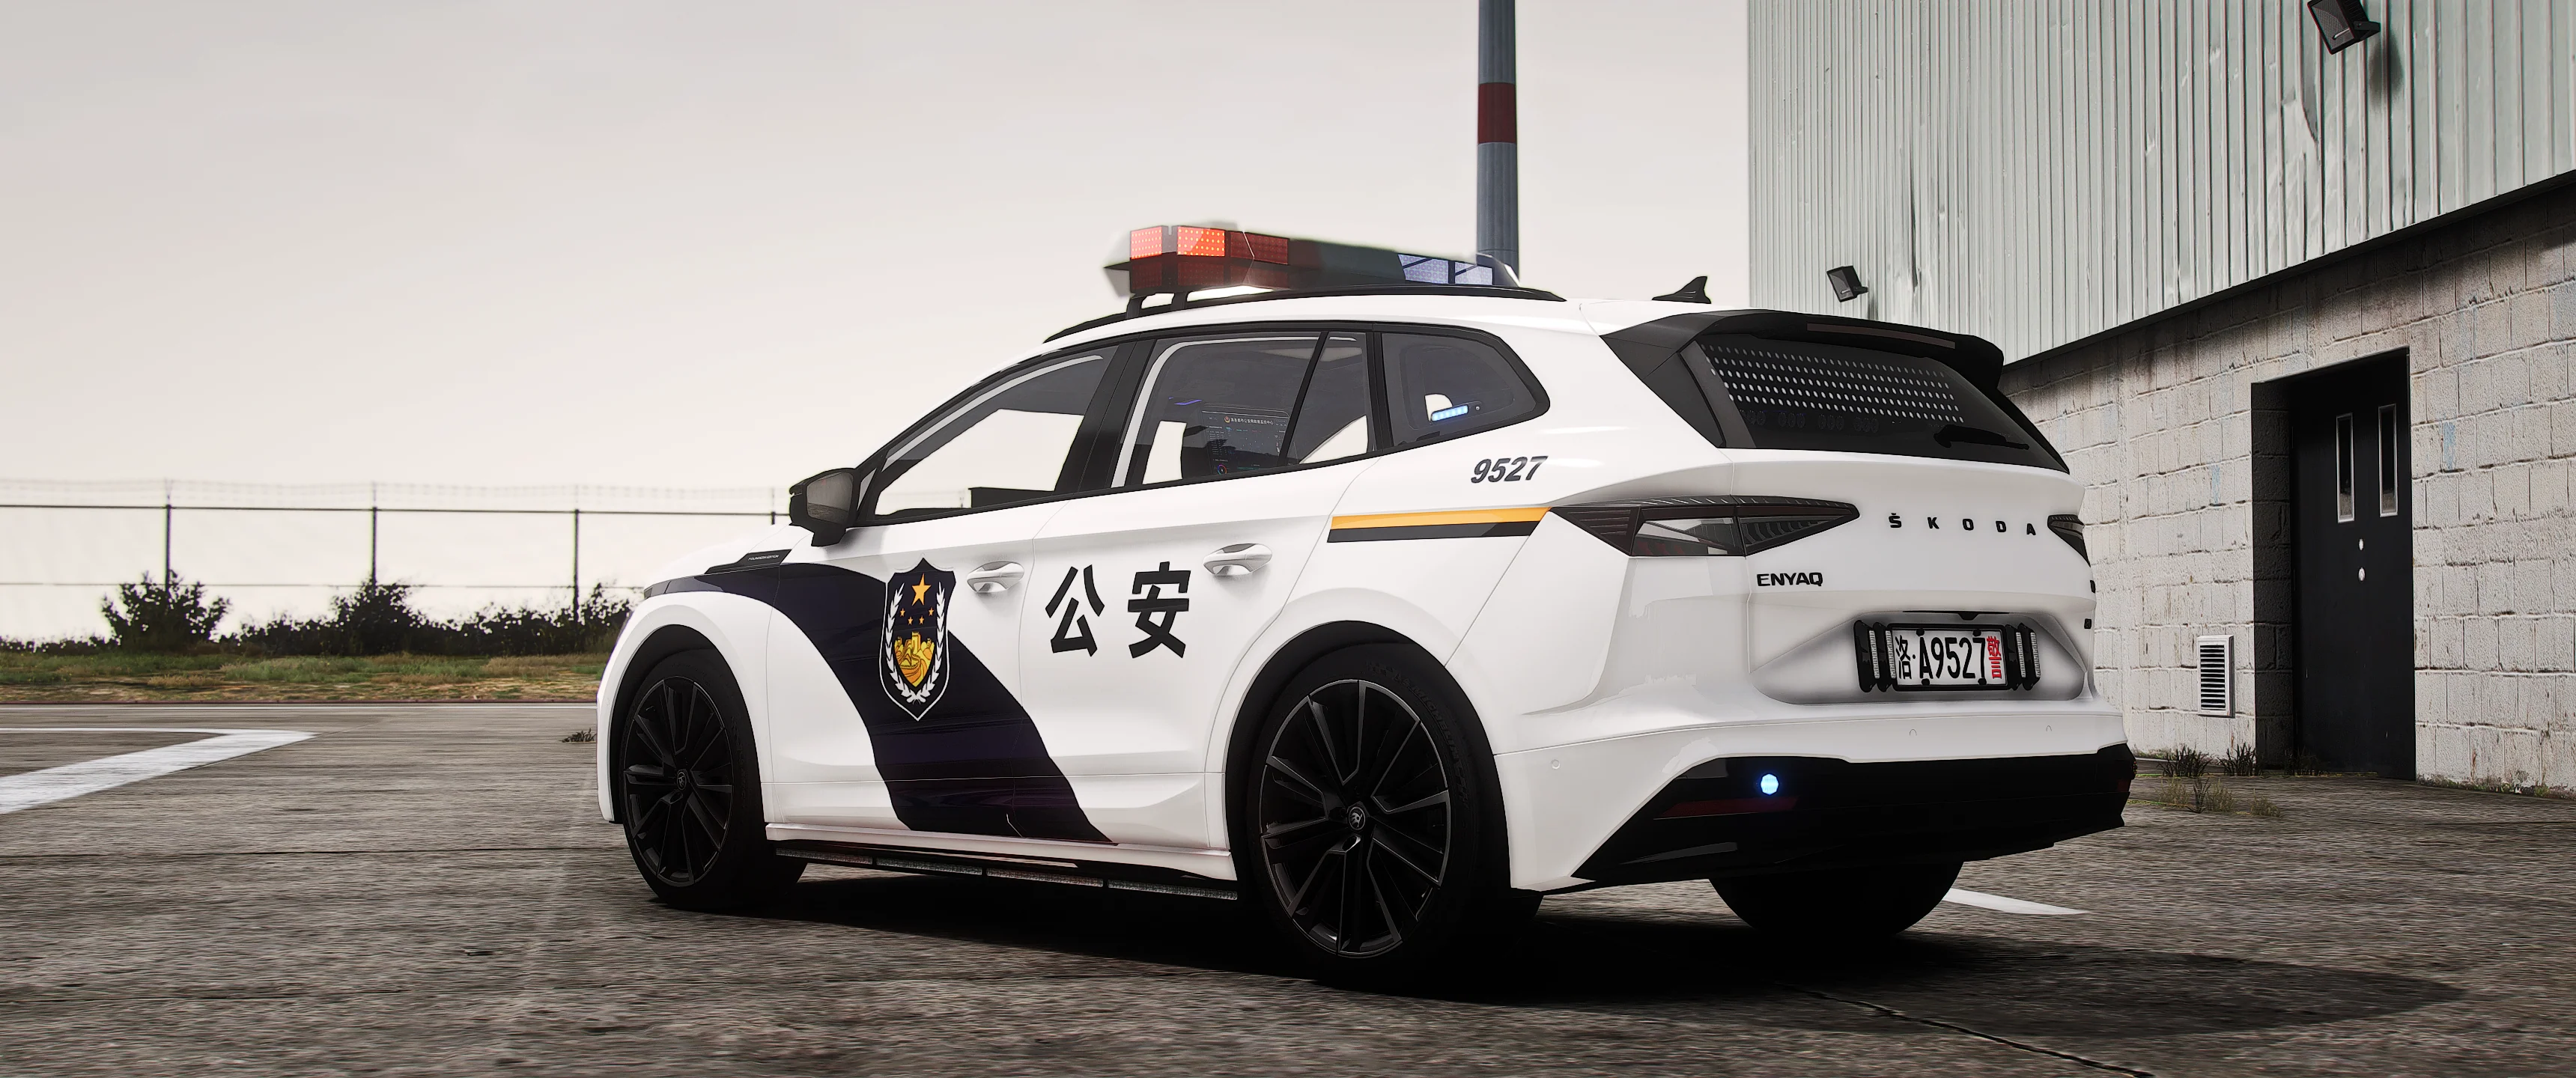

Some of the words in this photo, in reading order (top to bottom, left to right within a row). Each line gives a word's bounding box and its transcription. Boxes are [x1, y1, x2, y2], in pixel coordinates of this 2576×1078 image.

[1470, 455, 1549, 484] 9527
[1888, 512, 2037, 536] ŠKODA
[1756, 572, 1823, 587] ENYAQ
[1045, 561, 1191, 659] 公安
